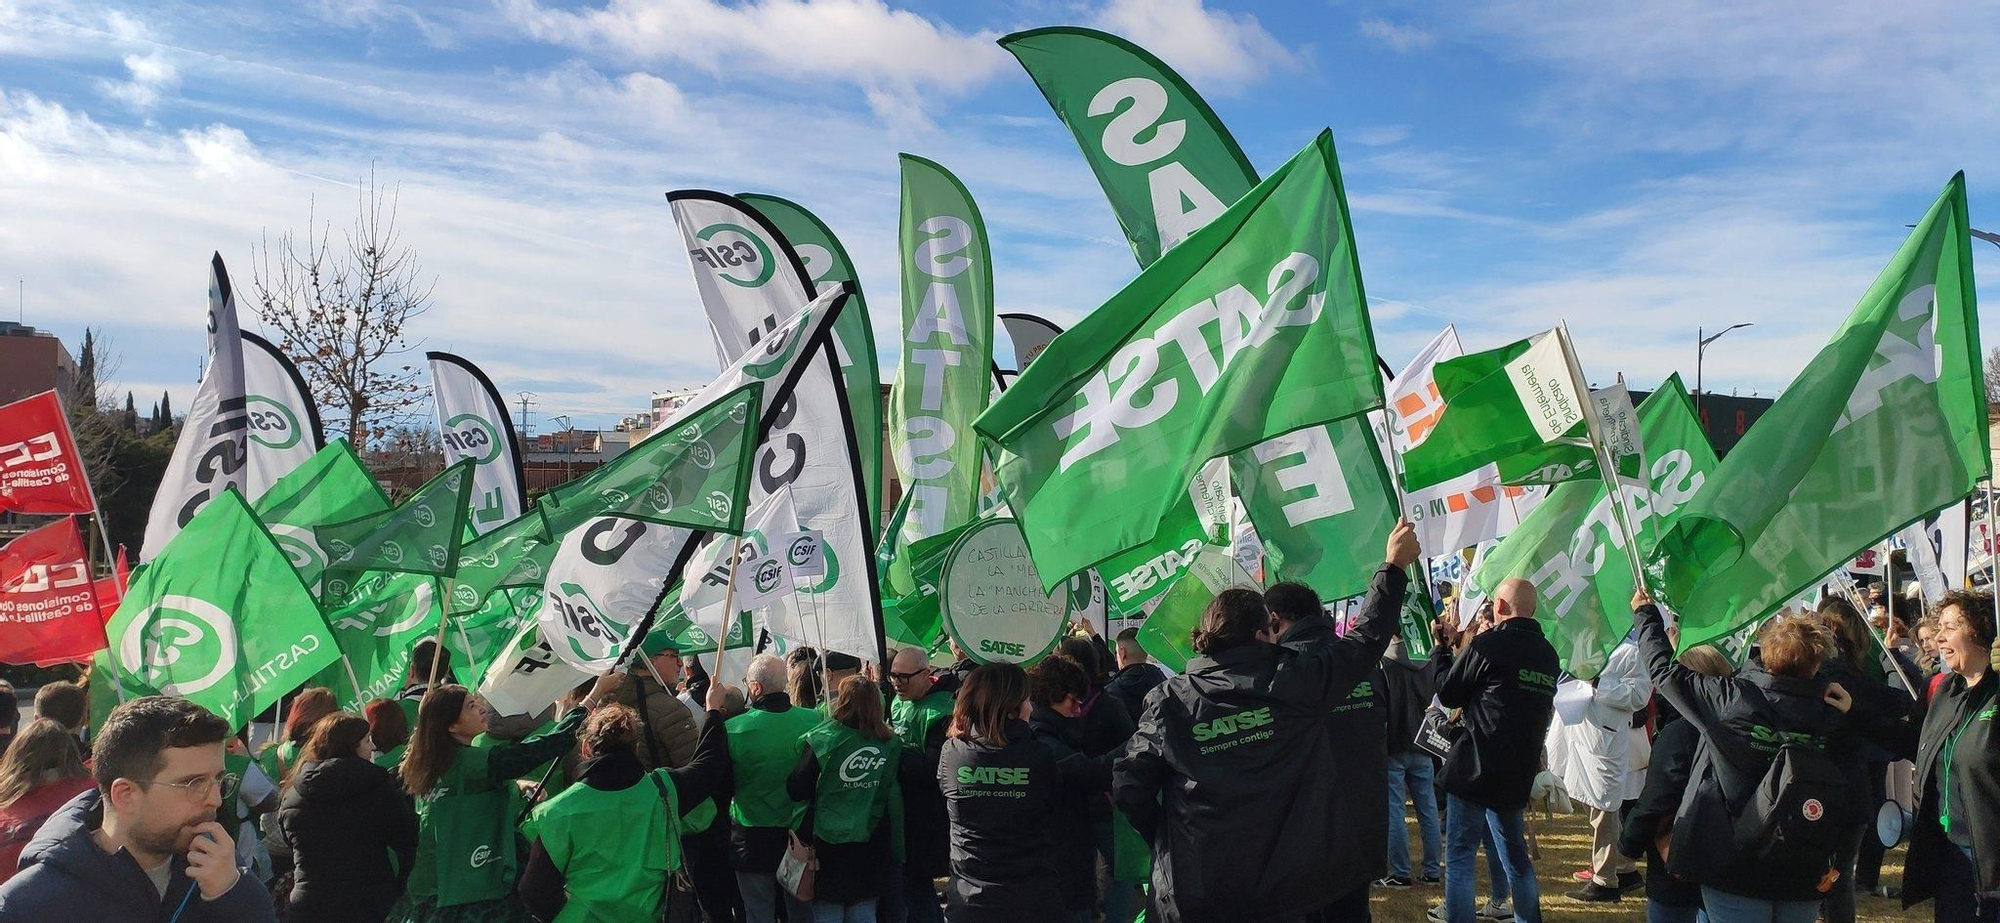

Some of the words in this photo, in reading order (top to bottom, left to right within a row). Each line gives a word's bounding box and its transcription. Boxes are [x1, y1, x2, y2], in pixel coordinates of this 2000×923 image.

[794, 543, 817, 558] CSIF
[967, 543, 1026, 563] CASTILLA
[760, 565, 783, 583] CSIF
[980, 639, 1026, 657] SATSE
[1192, 706, 1274, 742] SATSE
[1200, 739, 1238, 755] Siempre
[1240, 729, 1274, 744] contigo
[957, 766, 1030, 785] SATSE
[959, 788, 991, 798] Siempre
[993, 789, 1026, 799] contigo
